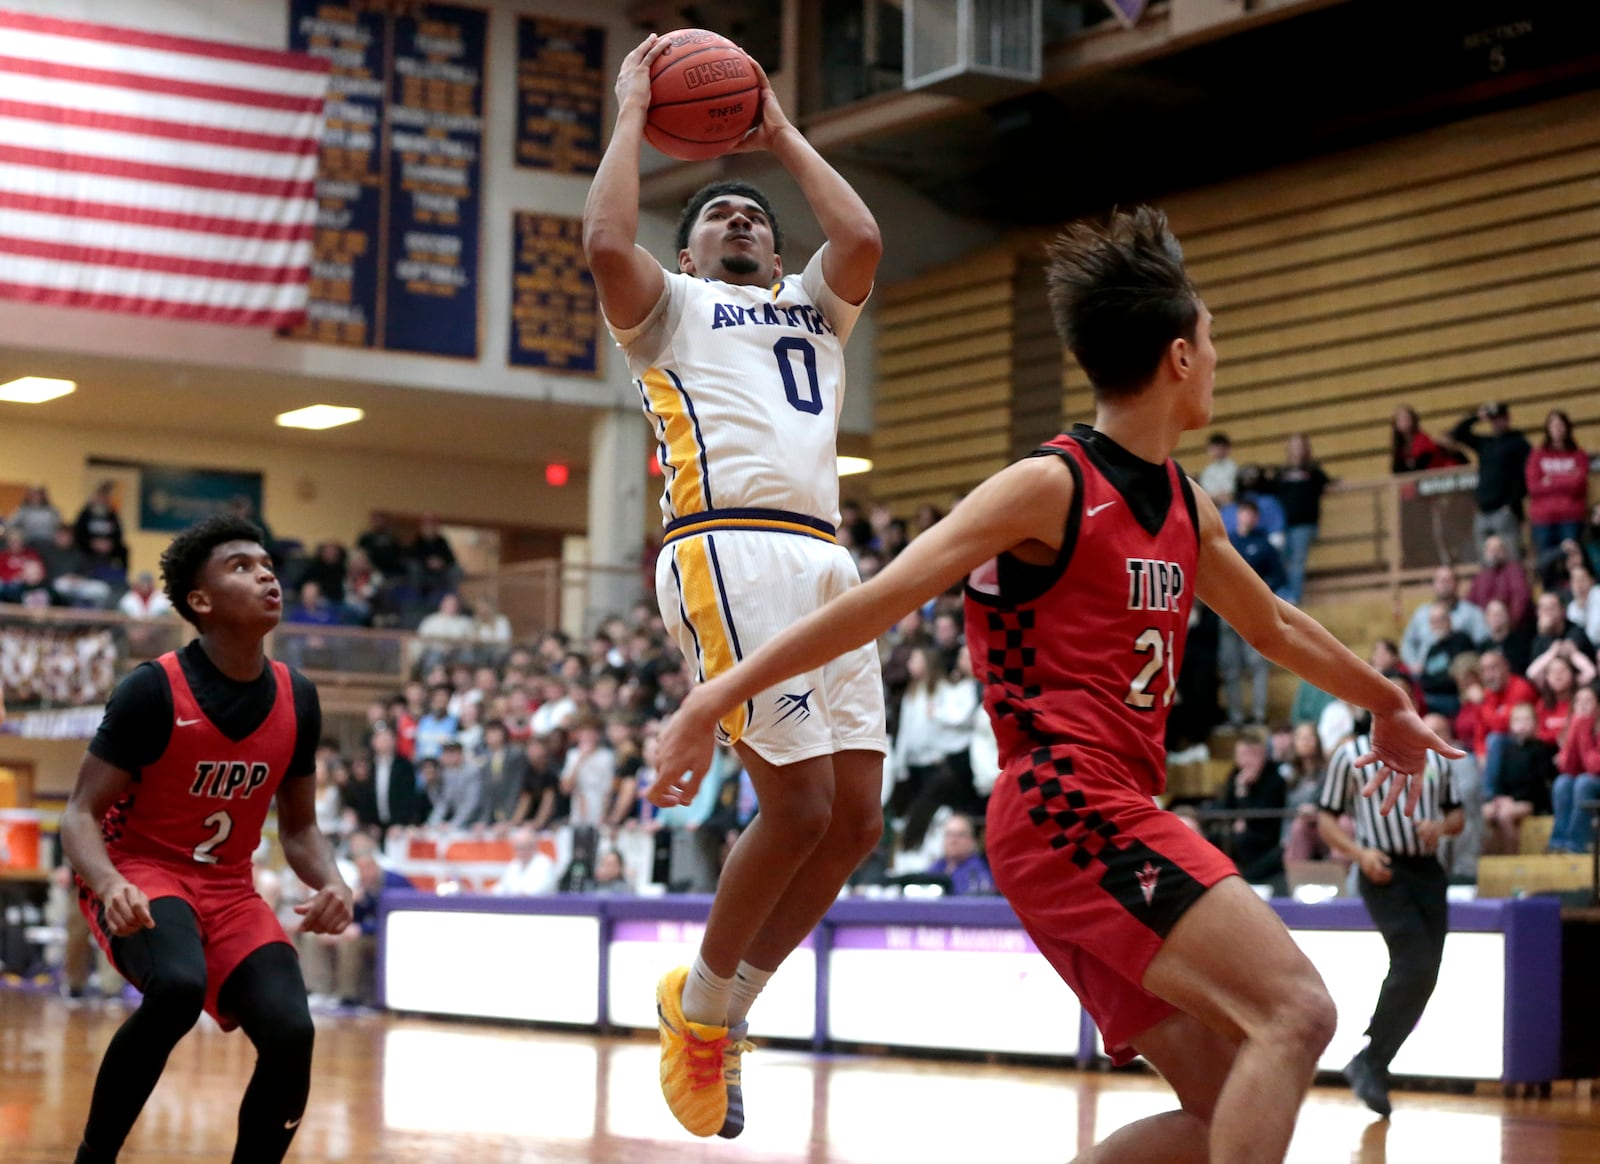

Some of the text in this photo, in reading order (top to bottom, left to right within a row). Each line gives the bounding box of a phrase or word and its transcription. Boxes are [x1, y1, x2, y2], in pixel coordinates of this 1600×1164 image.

[717, 103, 743, 118] NFHS
[773, 336, 823, 416] 0
[1126, 558, 1184, 612] TIPP
[1124, 628, 1176, 709] 21
[189, 761, 270, 799] TIPP
[193, 811, 232, 864] 2
